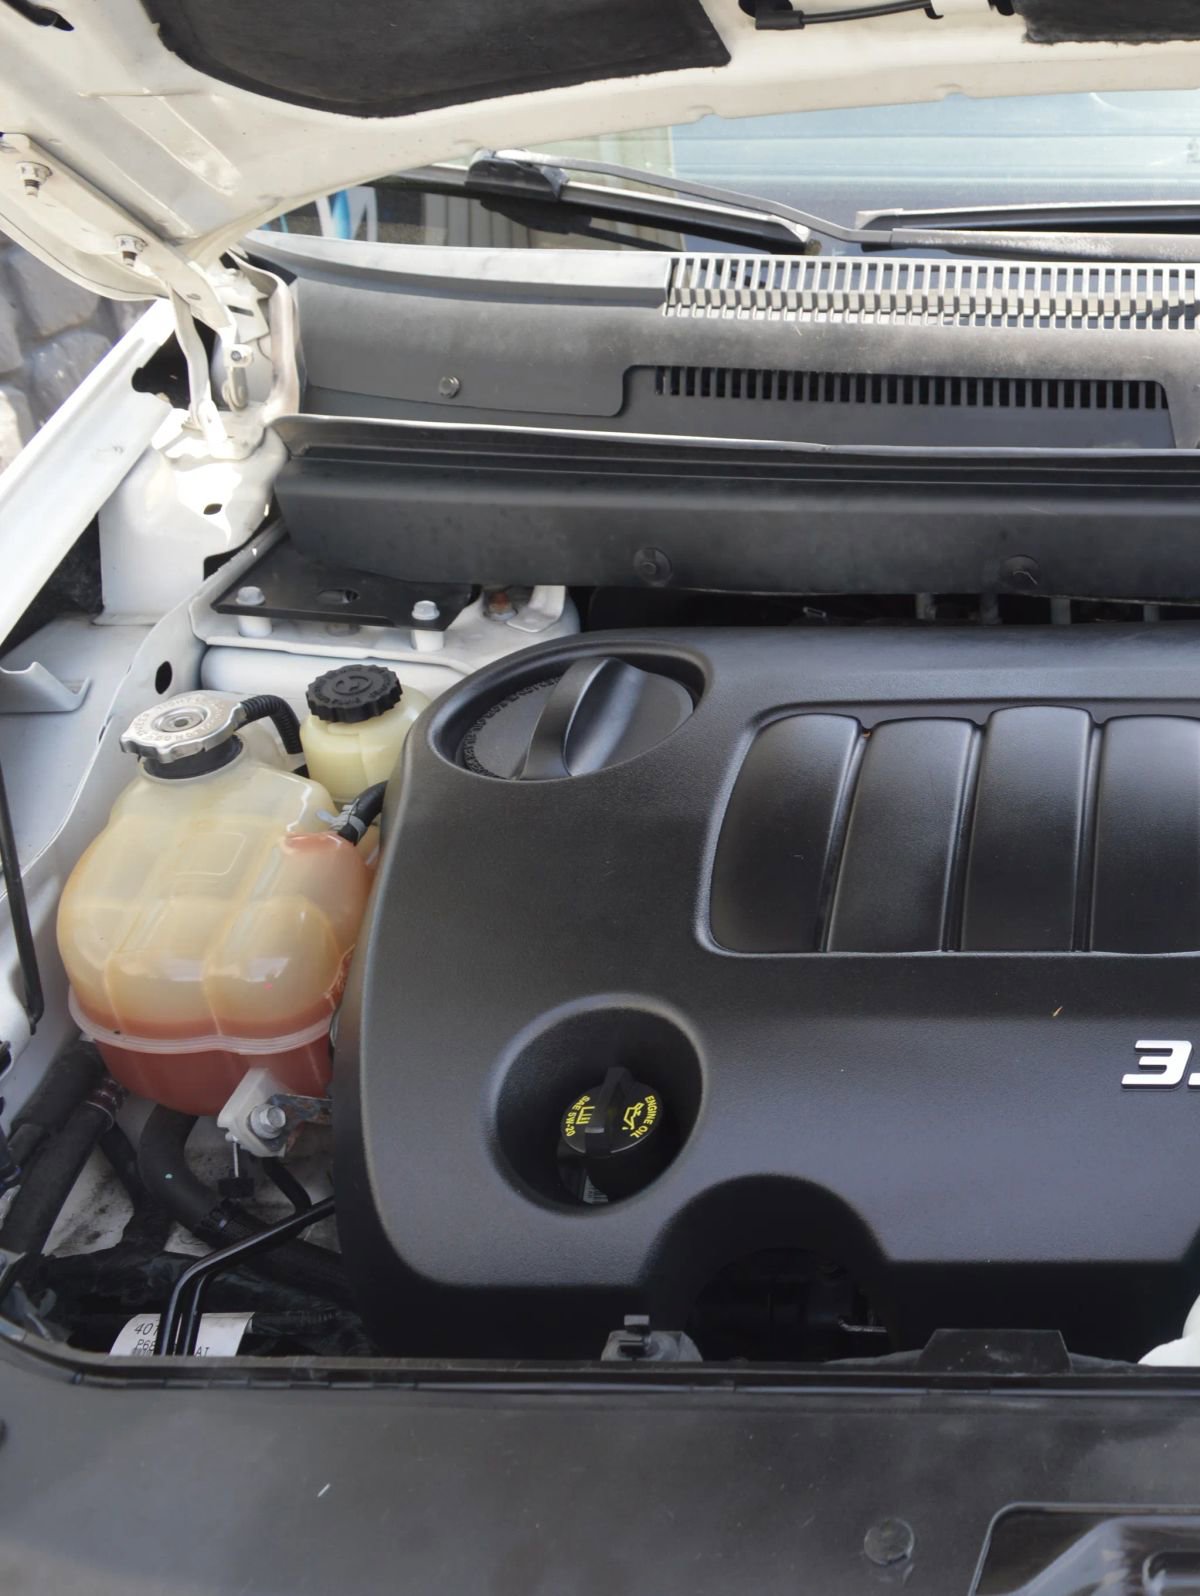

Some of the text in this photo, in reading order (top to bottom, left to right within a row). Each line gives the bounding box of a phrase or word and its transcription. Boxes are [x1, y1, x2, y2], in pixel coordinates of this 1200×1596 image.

[565, 1095, 591, 1137] SAE 5W-20
[630, 1095, 658, 1138] ENGINE OIL
